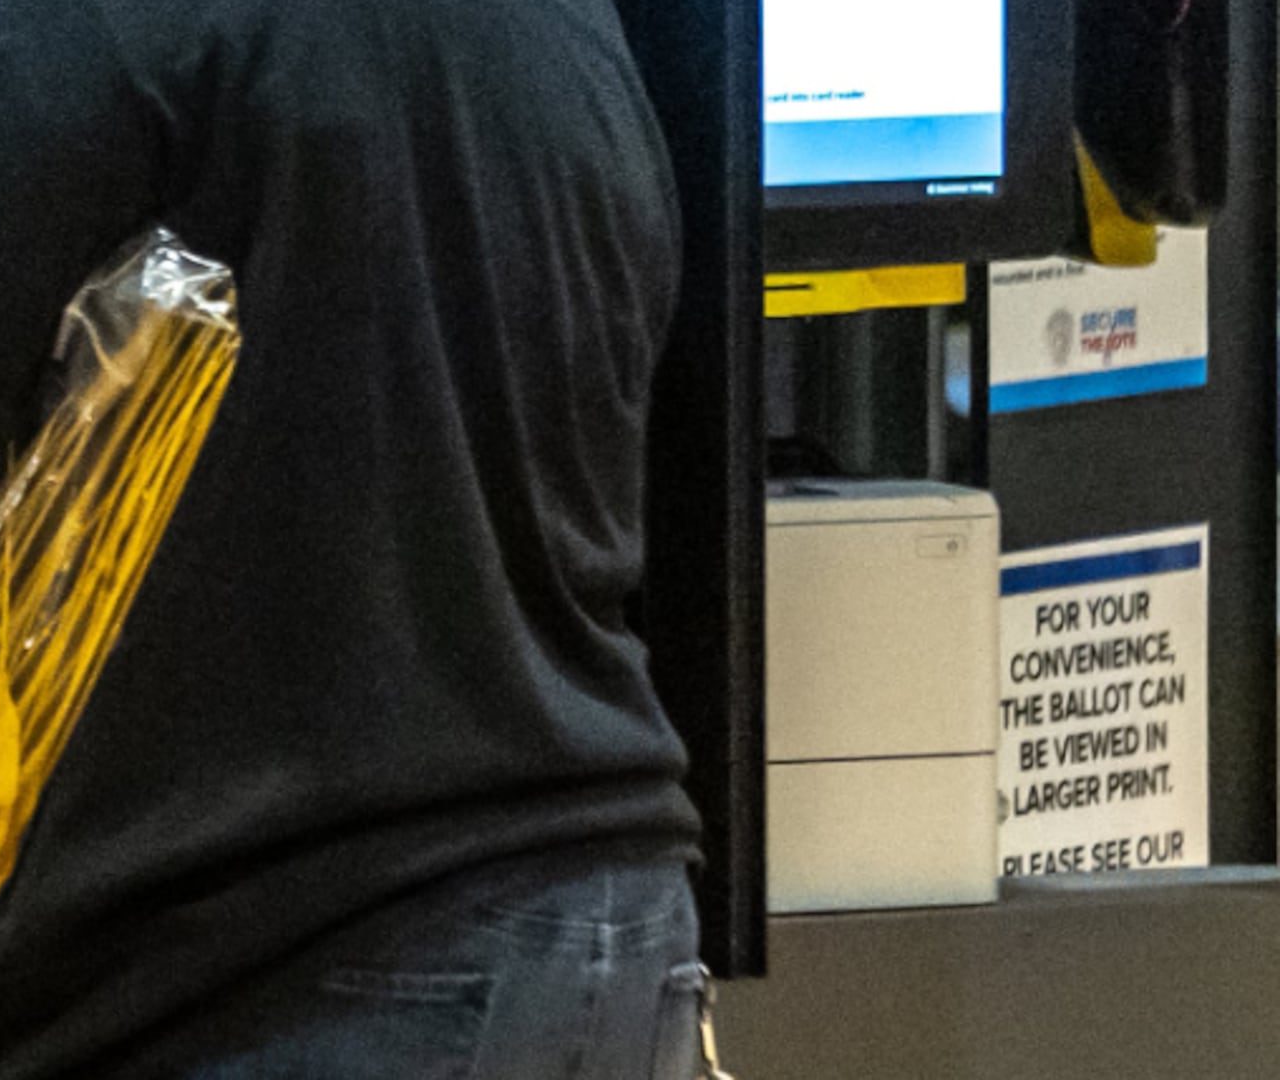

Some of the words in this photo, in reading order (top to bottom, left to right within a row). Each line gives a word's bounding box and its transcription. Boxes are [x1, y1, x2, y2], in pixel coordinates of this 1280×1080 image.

[1035, 603, 1078, 637] FOR
[1086, 592, 1149, 629] YOUR
[1010, 632, 1175, 683] CONVENIENCE,
[999, 696, 1042, 730] THE
[1049, 683, 1132, 723] BALLOT
[1139, 675, 1184, 709] CAN
[1020, 739, 1047, 772] BE
[1053, 726, 1138, 765] VIEWED
[1146, 721, 1166, 752] IN
[1013, 776, 1099, 816] LARGER
[1106, 764, 1172, 802] PRINT.
[1091, 839, 1129, 871] SEE
[1136, 831, 1183, 865] OUR
